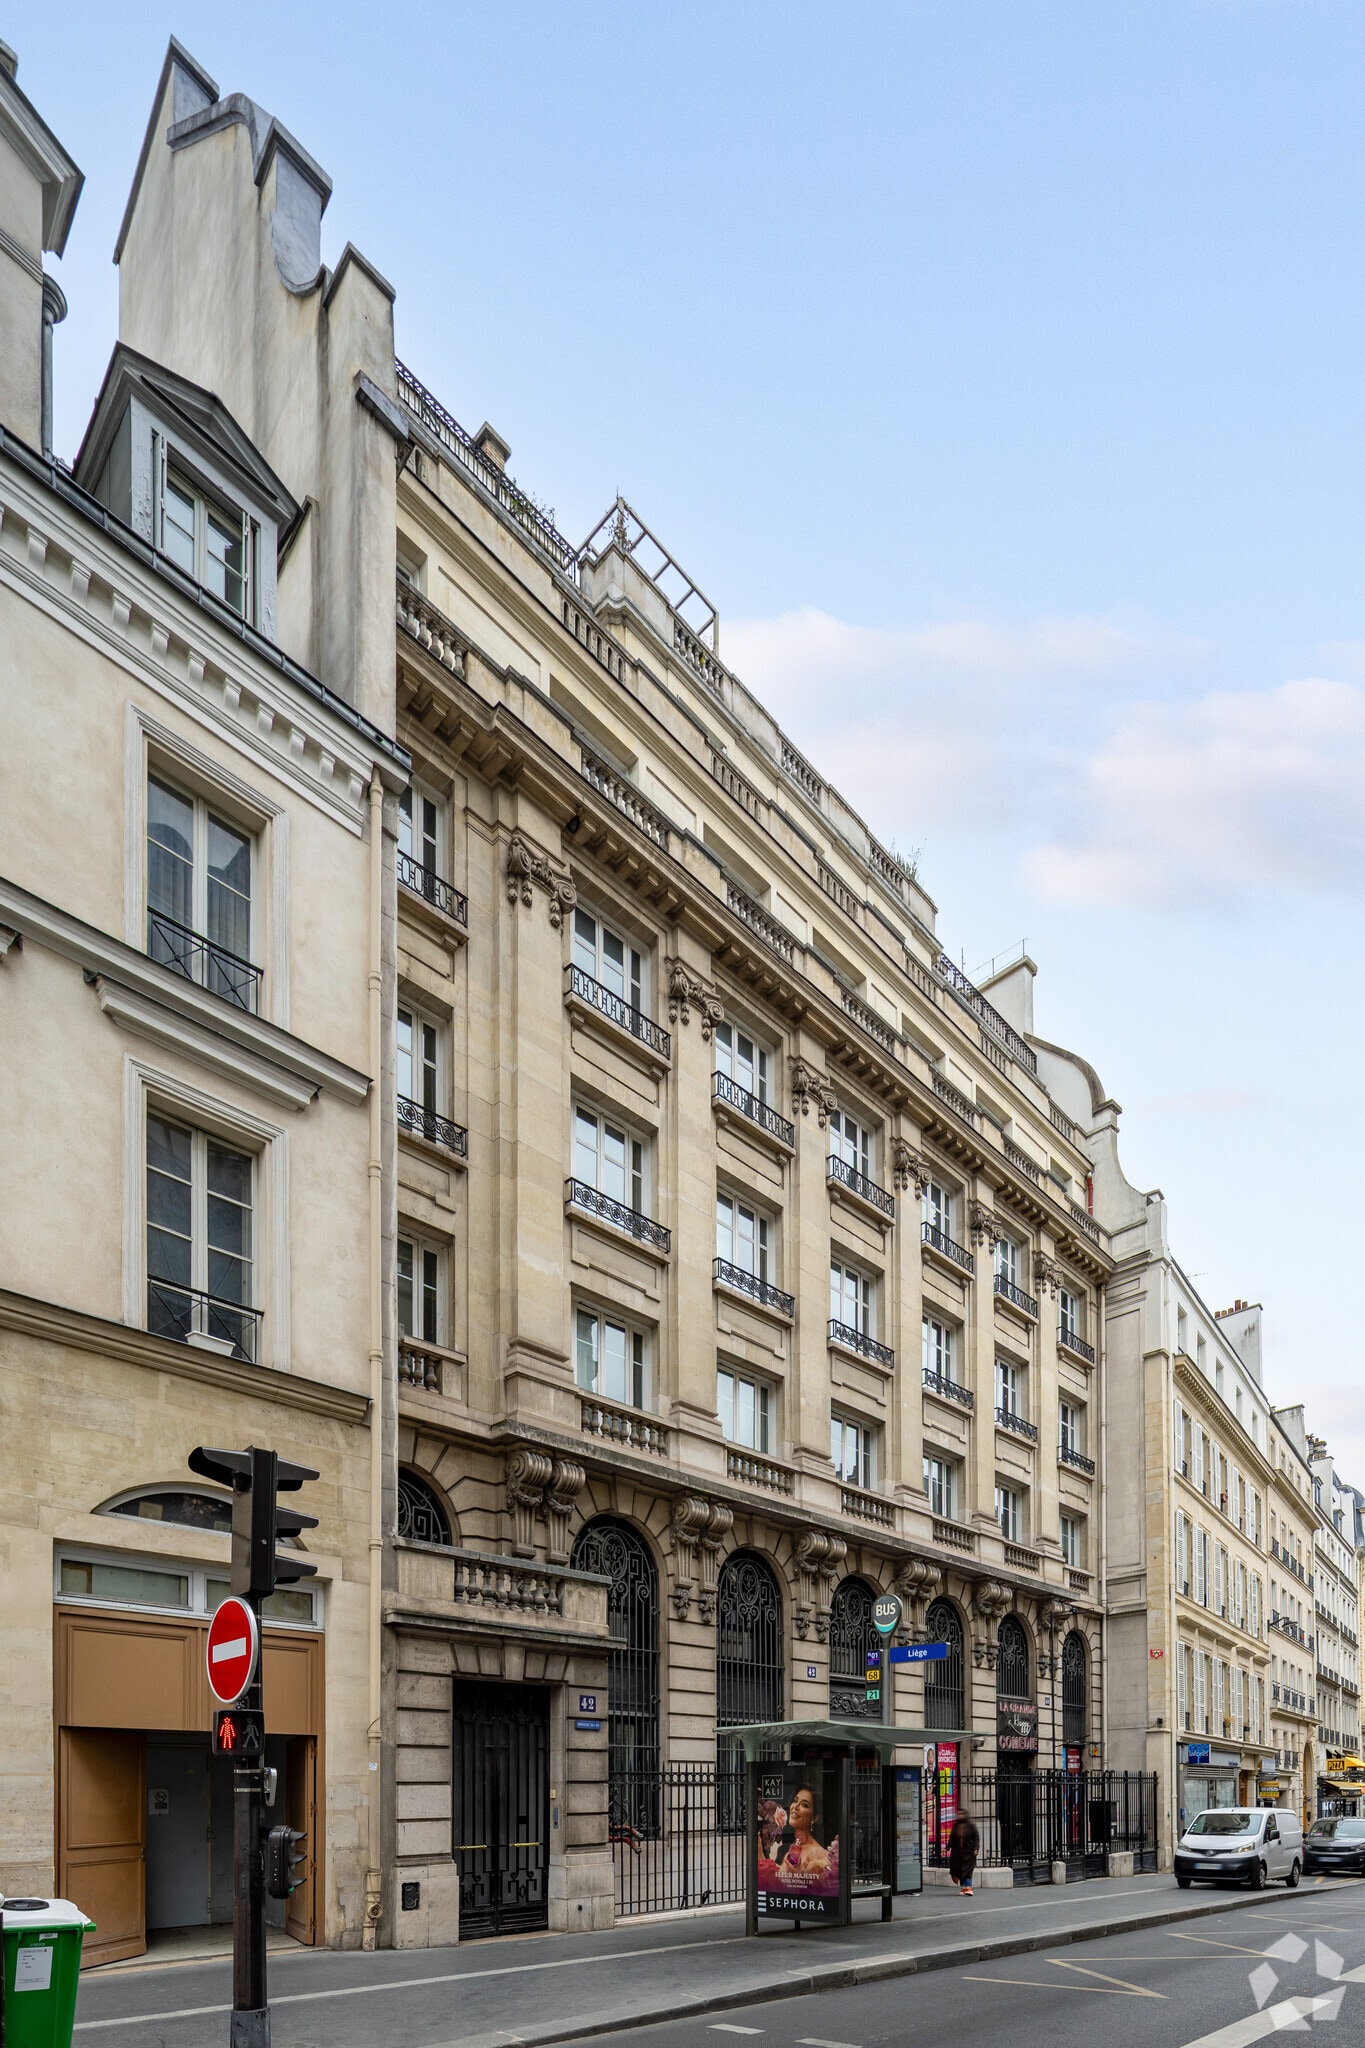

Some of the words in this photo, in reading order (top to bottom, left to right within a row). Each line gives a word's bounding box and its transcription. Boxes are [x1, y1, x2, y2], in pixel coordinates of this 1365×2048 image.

[875, 1602, 896, 1617] BUS
[907, 1649, 928, 1658] Liège
[868, 1671, 878, 1680] 68
[869, 1690, 878, 1699] 21
[581, 1697, 595, 1710] 42
[1000, 1701, 1009, 1712] LA
[1010, 1703, 1037, 1715] GRANDE
[1329, 1762, 1344, 1770] PIZZA
[769, 1897, 825, 1911] SEPHORA
